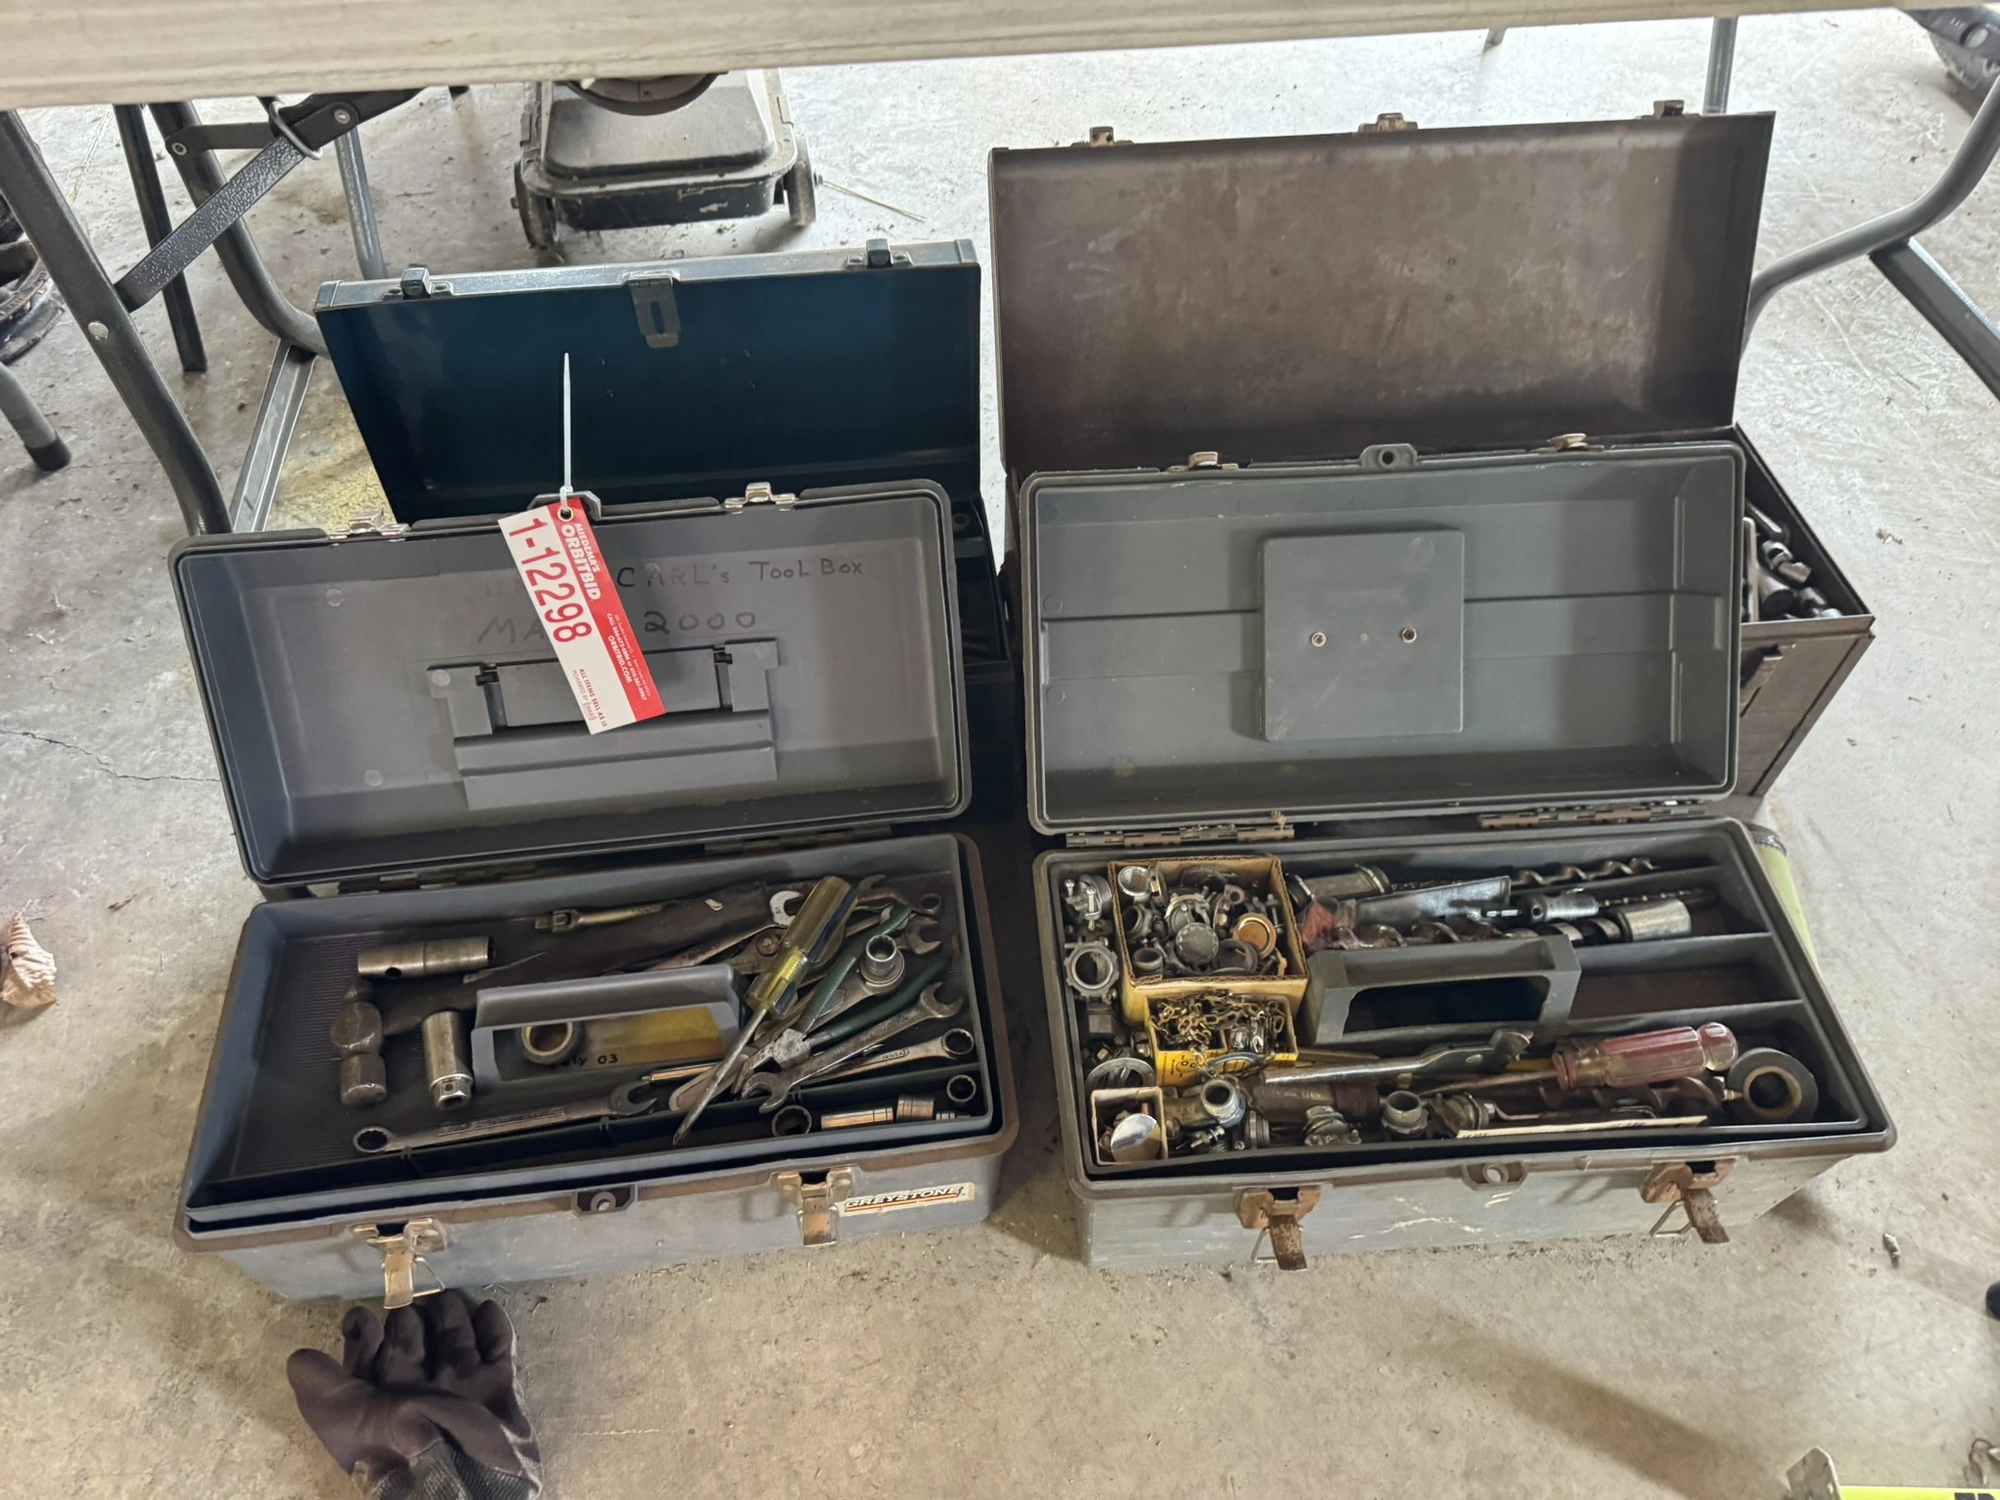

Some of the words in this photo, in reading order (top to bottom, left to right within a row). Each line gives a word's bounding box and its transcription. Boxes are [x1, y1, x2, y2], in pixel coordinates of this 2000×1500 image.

[561, 523, 600, 599] ORBITBID
[573, 523, 600, 572] MIEDEMA'S
[508, 517, 592, 642] 1-12298
[820, 558, 864, 576] Box
[477, 615, 546, 645] MA
[643, 610, 756, 634] 2000
[607, 612, 615, 625] CALL
[608, 635, 632, 682] ORBITBID.COM
[572, 669, 584, 689] POWERED
[583, 679, 595, 697] ITEMS
[591, 697, 600, 710] SELL
[596, 1053, 619, 1065] 03
[844, 1186, 962, 1208] GREYSTONE
